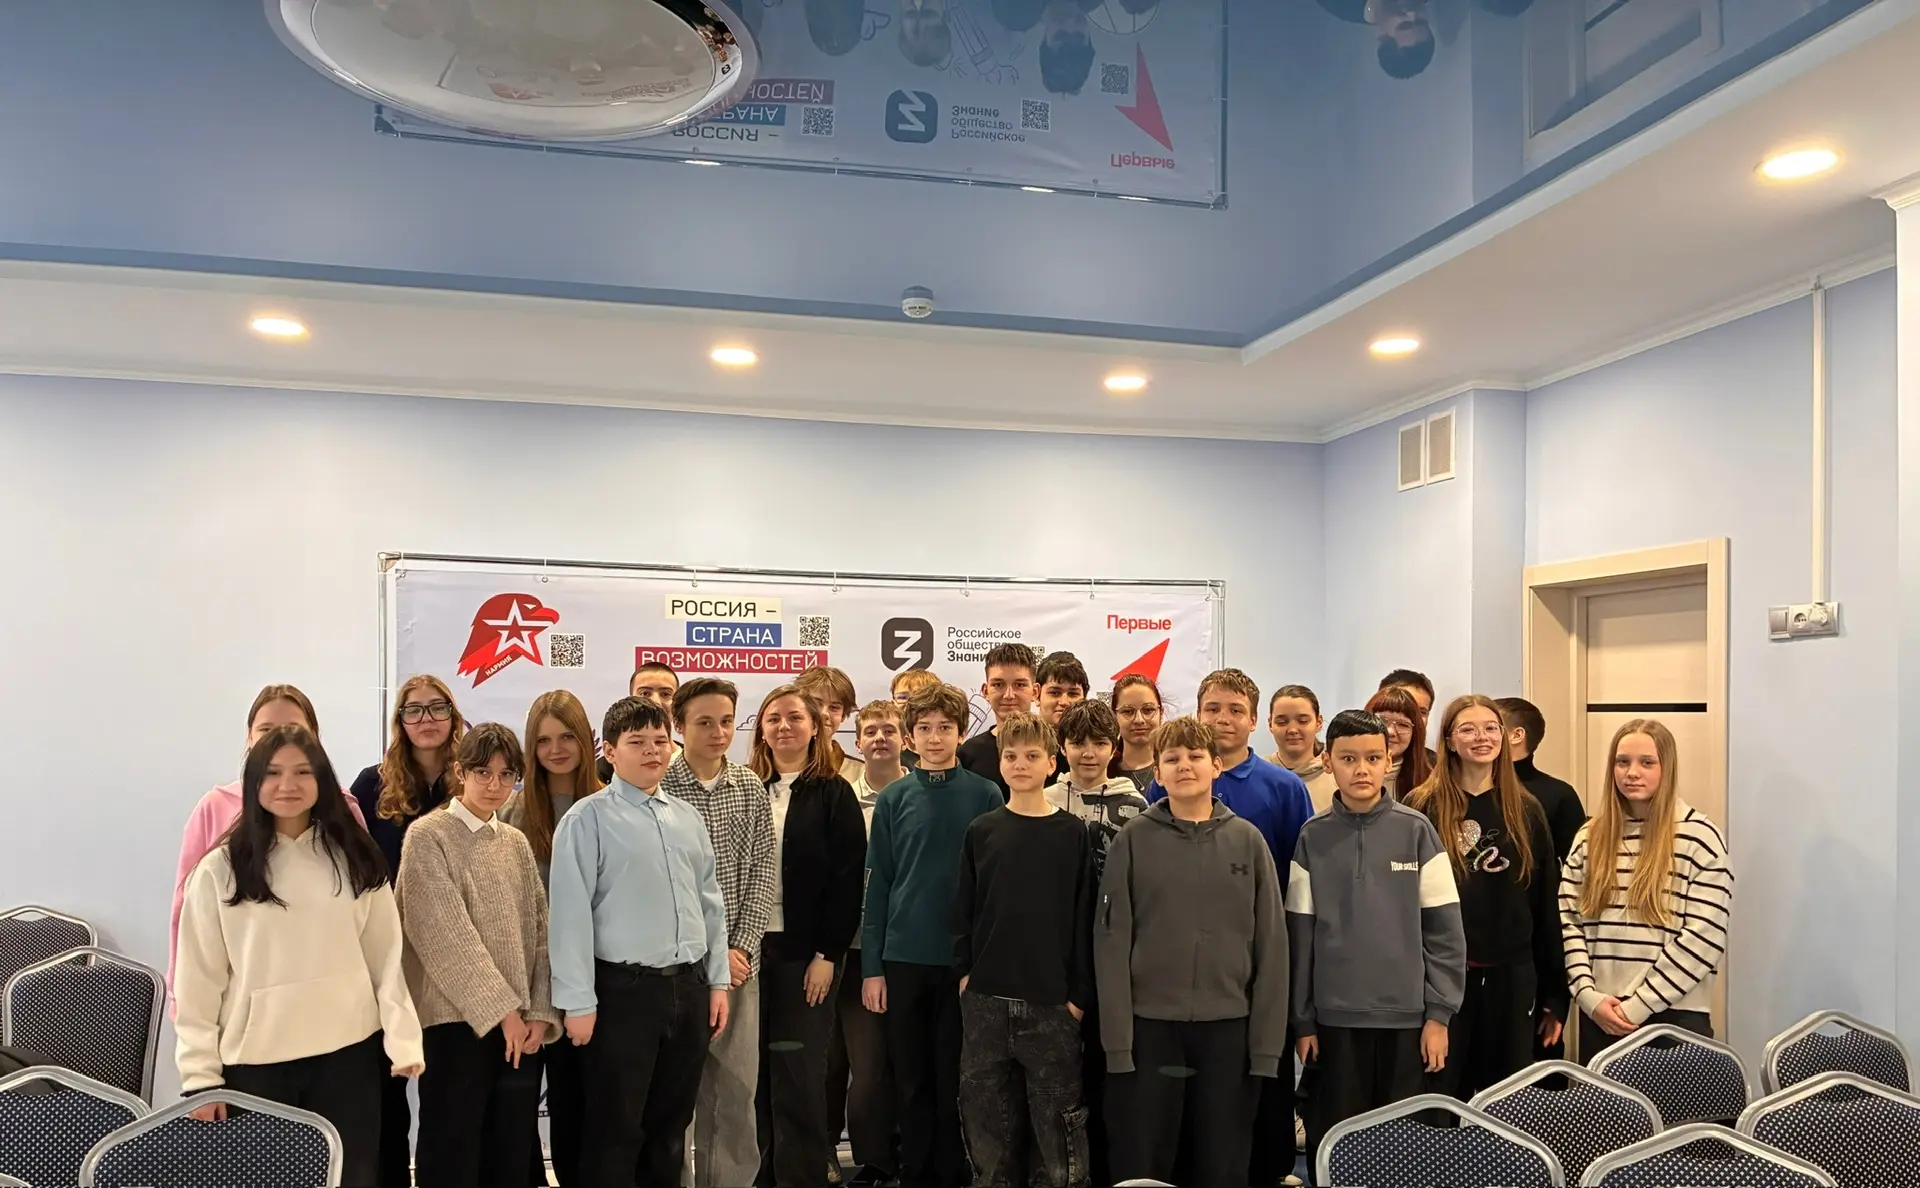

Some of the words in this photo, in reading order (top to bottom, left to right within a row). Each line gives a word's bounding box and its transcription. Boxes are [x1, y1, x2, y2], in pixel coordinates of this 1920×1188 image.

[671, 599, 756, 617] РОССИЯ
[947, 627, 1021, 639] Российское
[1107, 614, 1172, 634] Первые
[692, 626, 775, 645] СТРАНА
[947, 650, 987, 662] Знани
